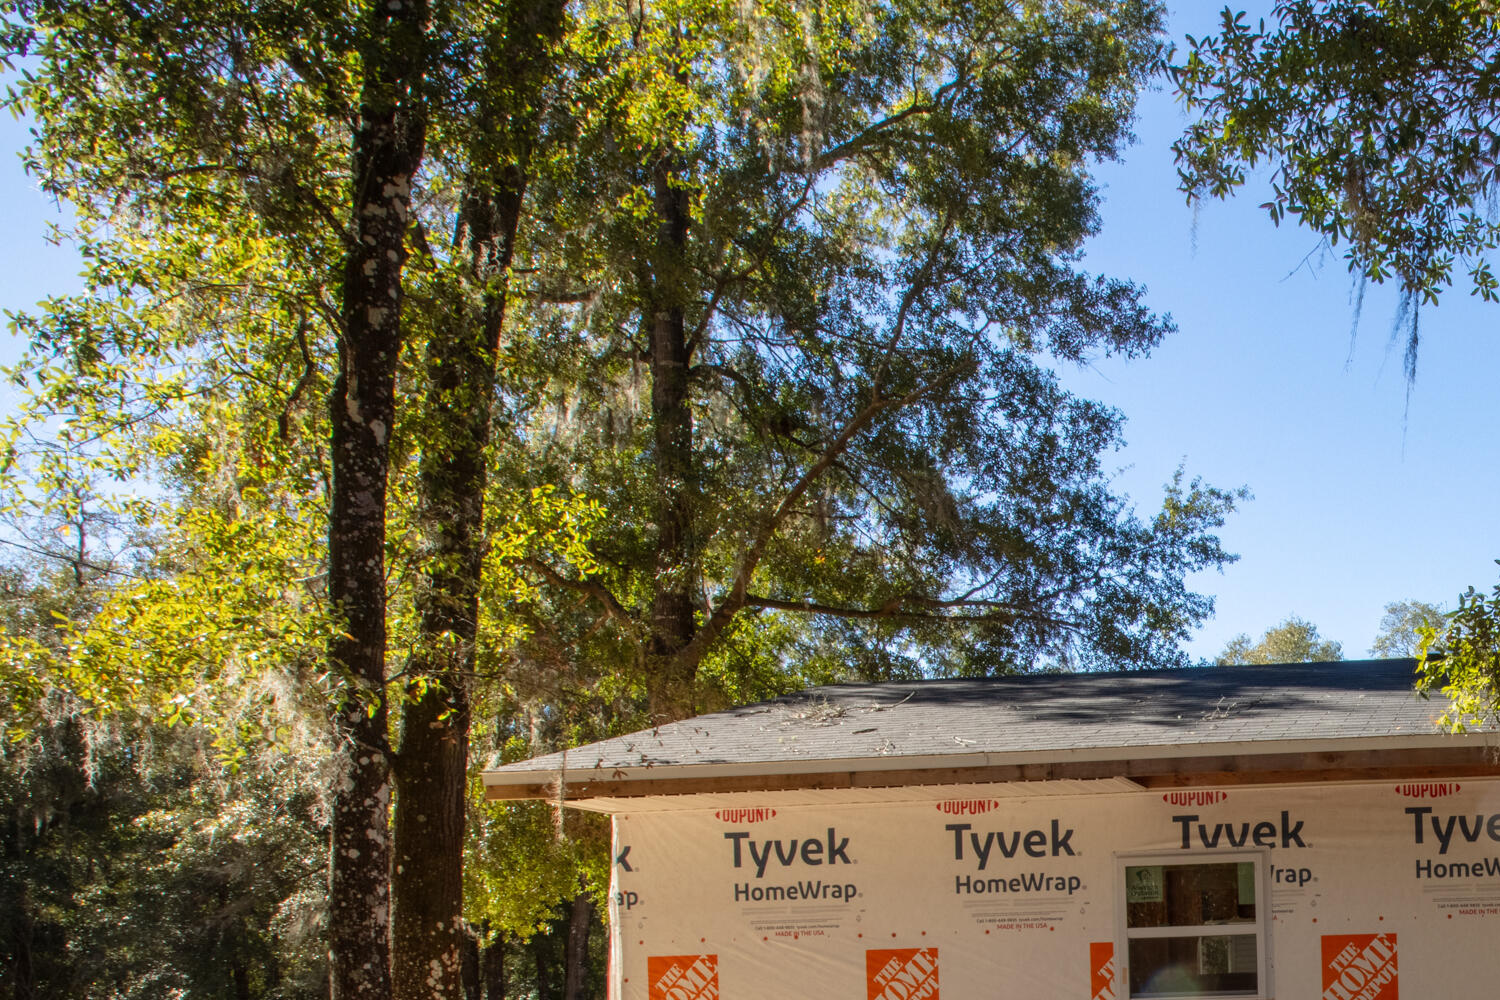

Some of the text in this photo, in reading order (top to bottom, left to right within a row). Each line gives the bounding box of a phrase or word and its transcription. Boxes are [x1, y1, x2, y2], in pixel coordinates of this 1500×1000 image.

[1171, 791, 1219, 806] DUPONT
[1403, 783, 1453, 798] DUPONT
[723, 808, 770, 823] DUPONT
[944, 800, 992, 815] DUPONT
[724, 828, 852, 878] Tyvek
[945, 819, 1076, 870] Tyvek
[734, 881, 857, 903] HomeWrap
[956, 873, 1081, 895] HomeWrap
[1329, 942, 1361, 972] THE
[655, 963, 684, 992] THE
[873, 956, 903, 986] THE
